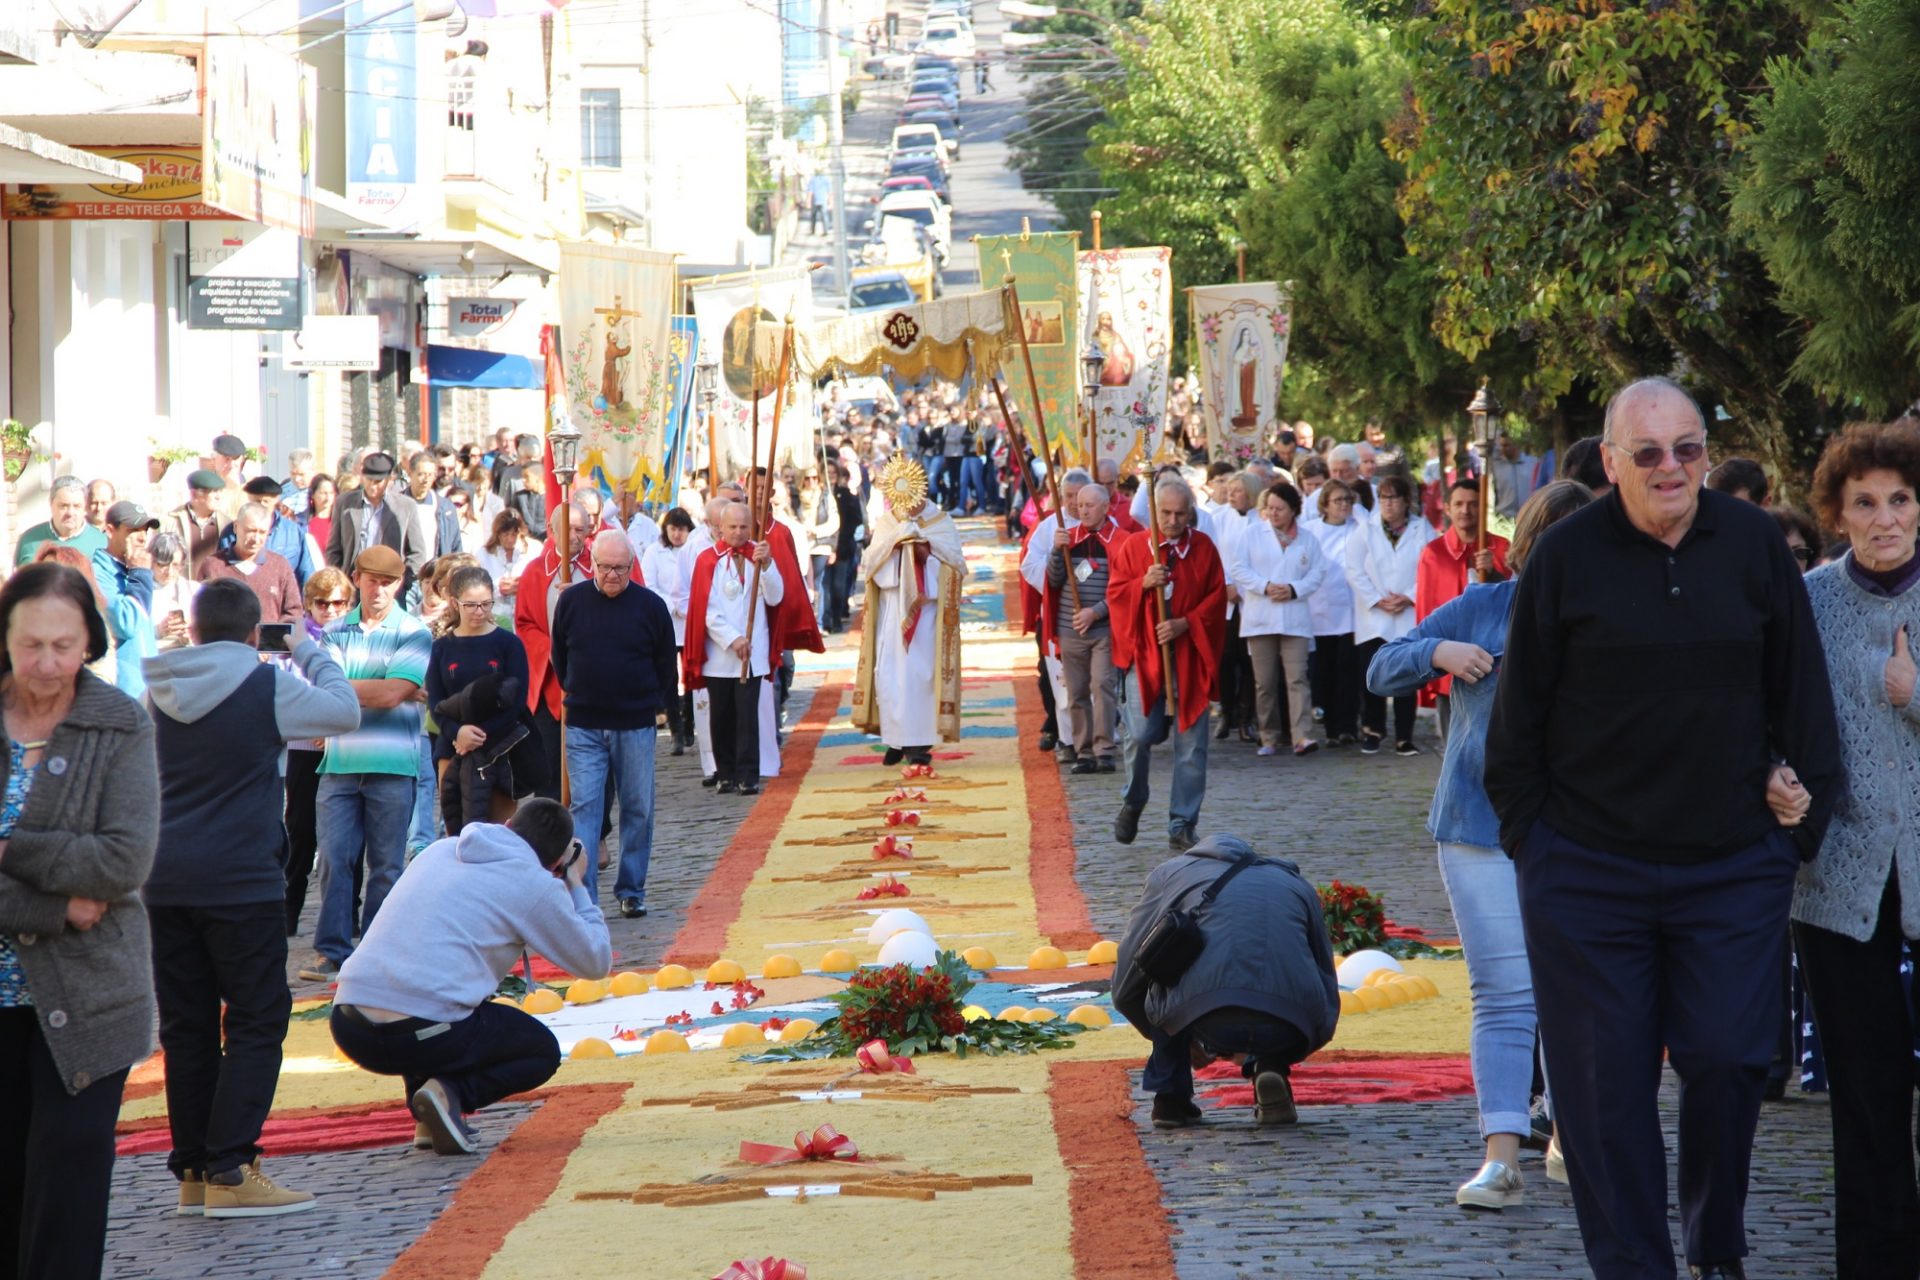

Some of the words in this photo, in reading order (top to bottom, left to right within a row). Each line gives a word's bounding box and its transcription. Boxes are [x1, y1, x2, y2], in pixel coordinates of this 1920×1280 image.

[358, 195, 396, 206] Farma
[76, 204, 183, 216] TELE-ENTREGA
[208, 278, 235, 288] projeto
[243, 279, 282, 288] execução
[199, 288, 241, 297] arquitetura
[242, 288, 253, 296] de
[254, 288, 290, 297] interiores
[211, 297, 237, 306] design
[238, 297, 249, 306] de
[250, 297, 279, 306] móveis
[207, 307, 258, 316] programação
[259, 307, 283, 315] visual
[469, 303, 502, 315] Total
[223, 316, 267, 325] consultoria
[459, 312, 503, 323] Farma
